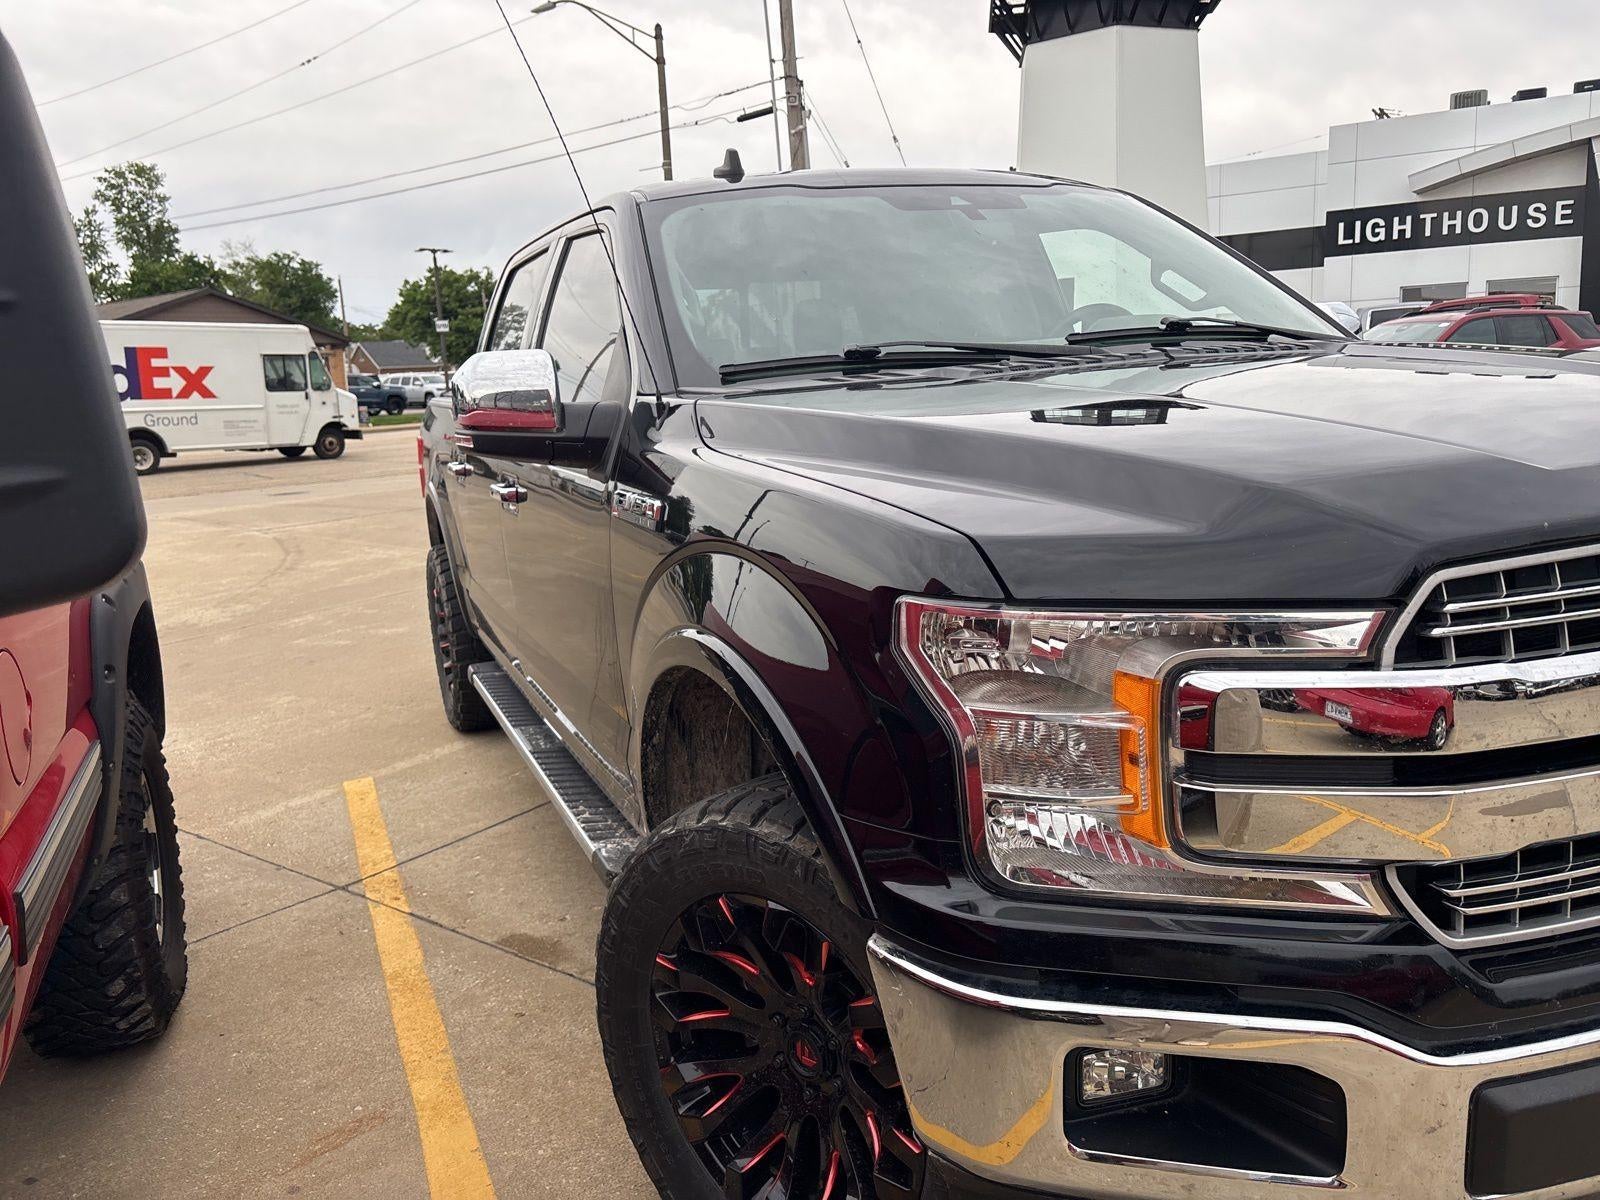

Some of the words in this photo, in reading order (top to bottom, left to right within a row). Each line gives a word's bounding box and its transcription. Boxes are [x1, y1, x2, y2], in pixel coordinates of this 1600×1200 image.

[1338, 200, 1574, 244] LIGHTHOUSE
[110, 346, 217, 401] dEx
[144, 413, 198, 428] Ground
